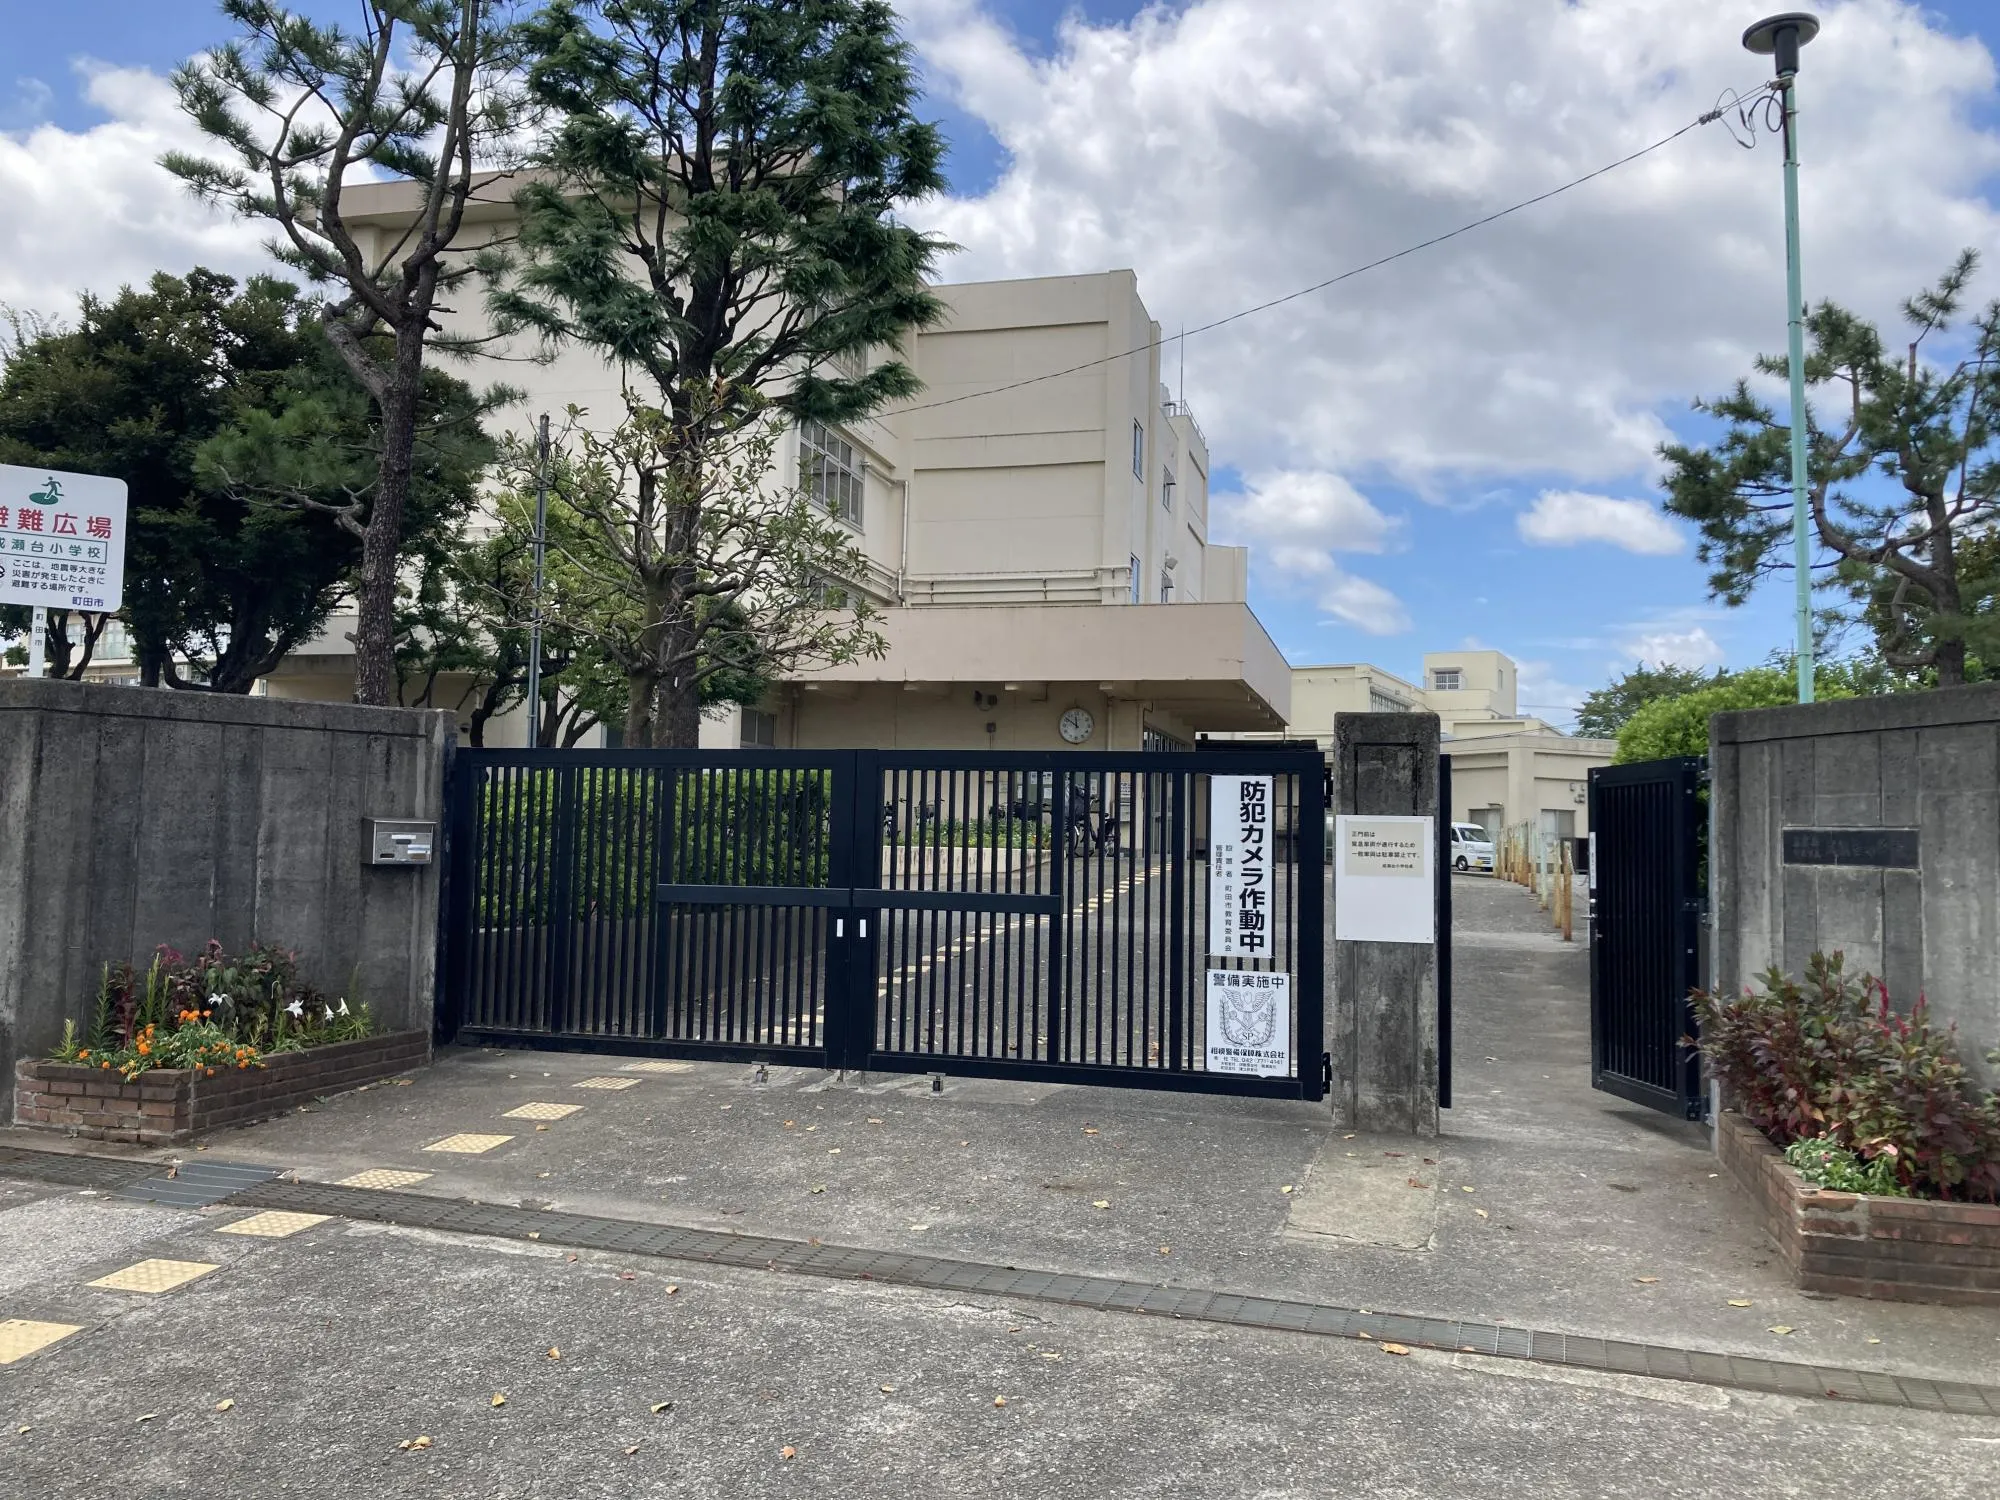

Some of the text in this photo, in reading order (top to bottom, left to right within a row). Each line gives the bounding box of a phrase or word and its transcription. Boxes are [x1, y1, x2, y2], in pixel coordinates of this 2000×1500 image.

[12, 569, 105, 585] 災害が発生したときに
[72, 596, 104, 607] 町田市
[1238, 781, 1267, 953] 防犯カメラ作動中
[1212, 973, 1284, 989] 警備実施中
[1241, 1032, 1254, 1041] SP
[1211, 1047, 1285, 1059] 相模警備保障株式会社
